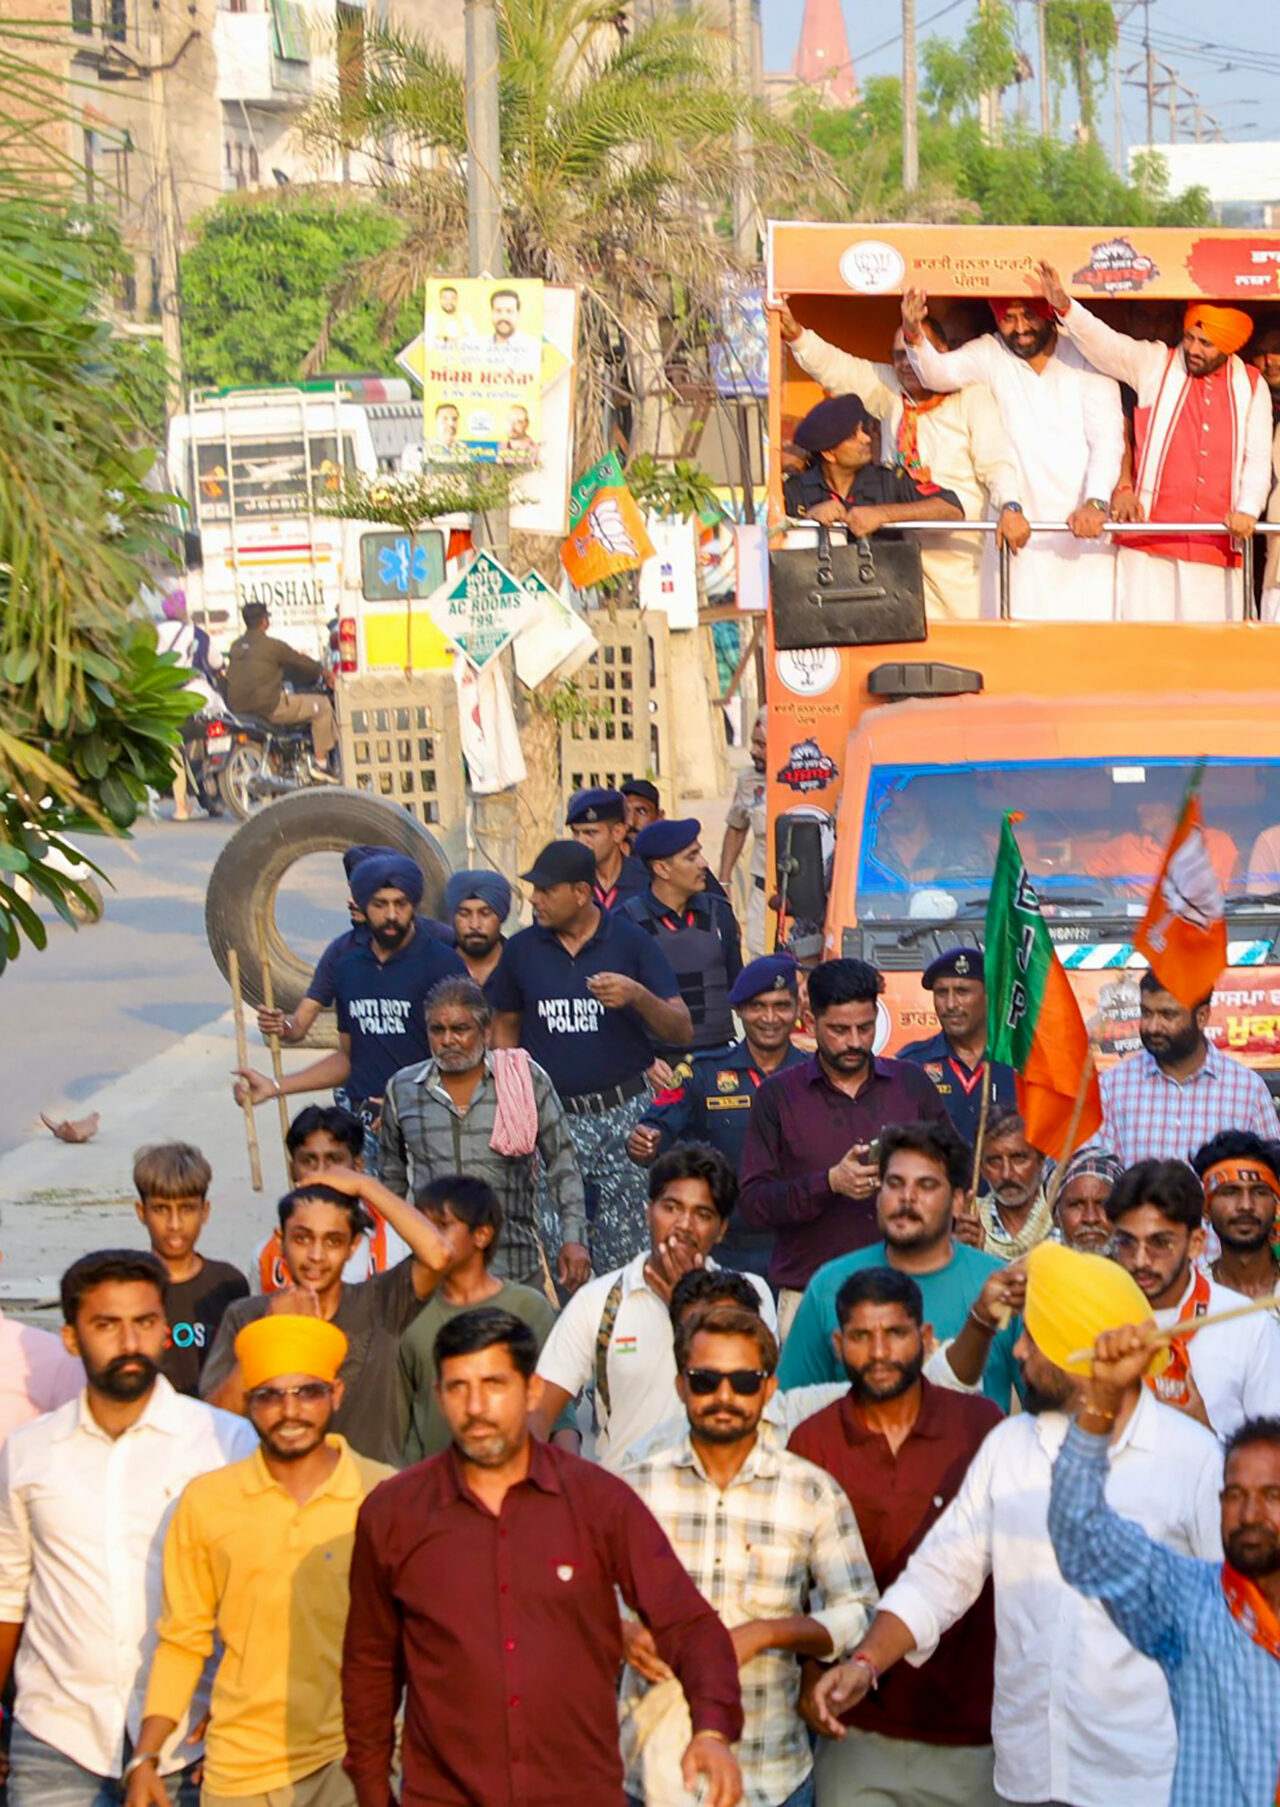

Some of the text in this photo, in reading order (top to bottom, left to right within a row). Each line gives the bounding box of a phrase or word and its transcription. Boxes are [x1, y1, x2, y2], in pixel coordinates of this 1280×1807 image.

[449, 595, 521, 615] AC ROOMS
[349, 998, 412, 1018] ANTI RIOT
[538, 998, 570, 1018] ANTI
[359, 1016, 406, 1036] POLICE
[547, 1015, 599, 1034] POLICE
